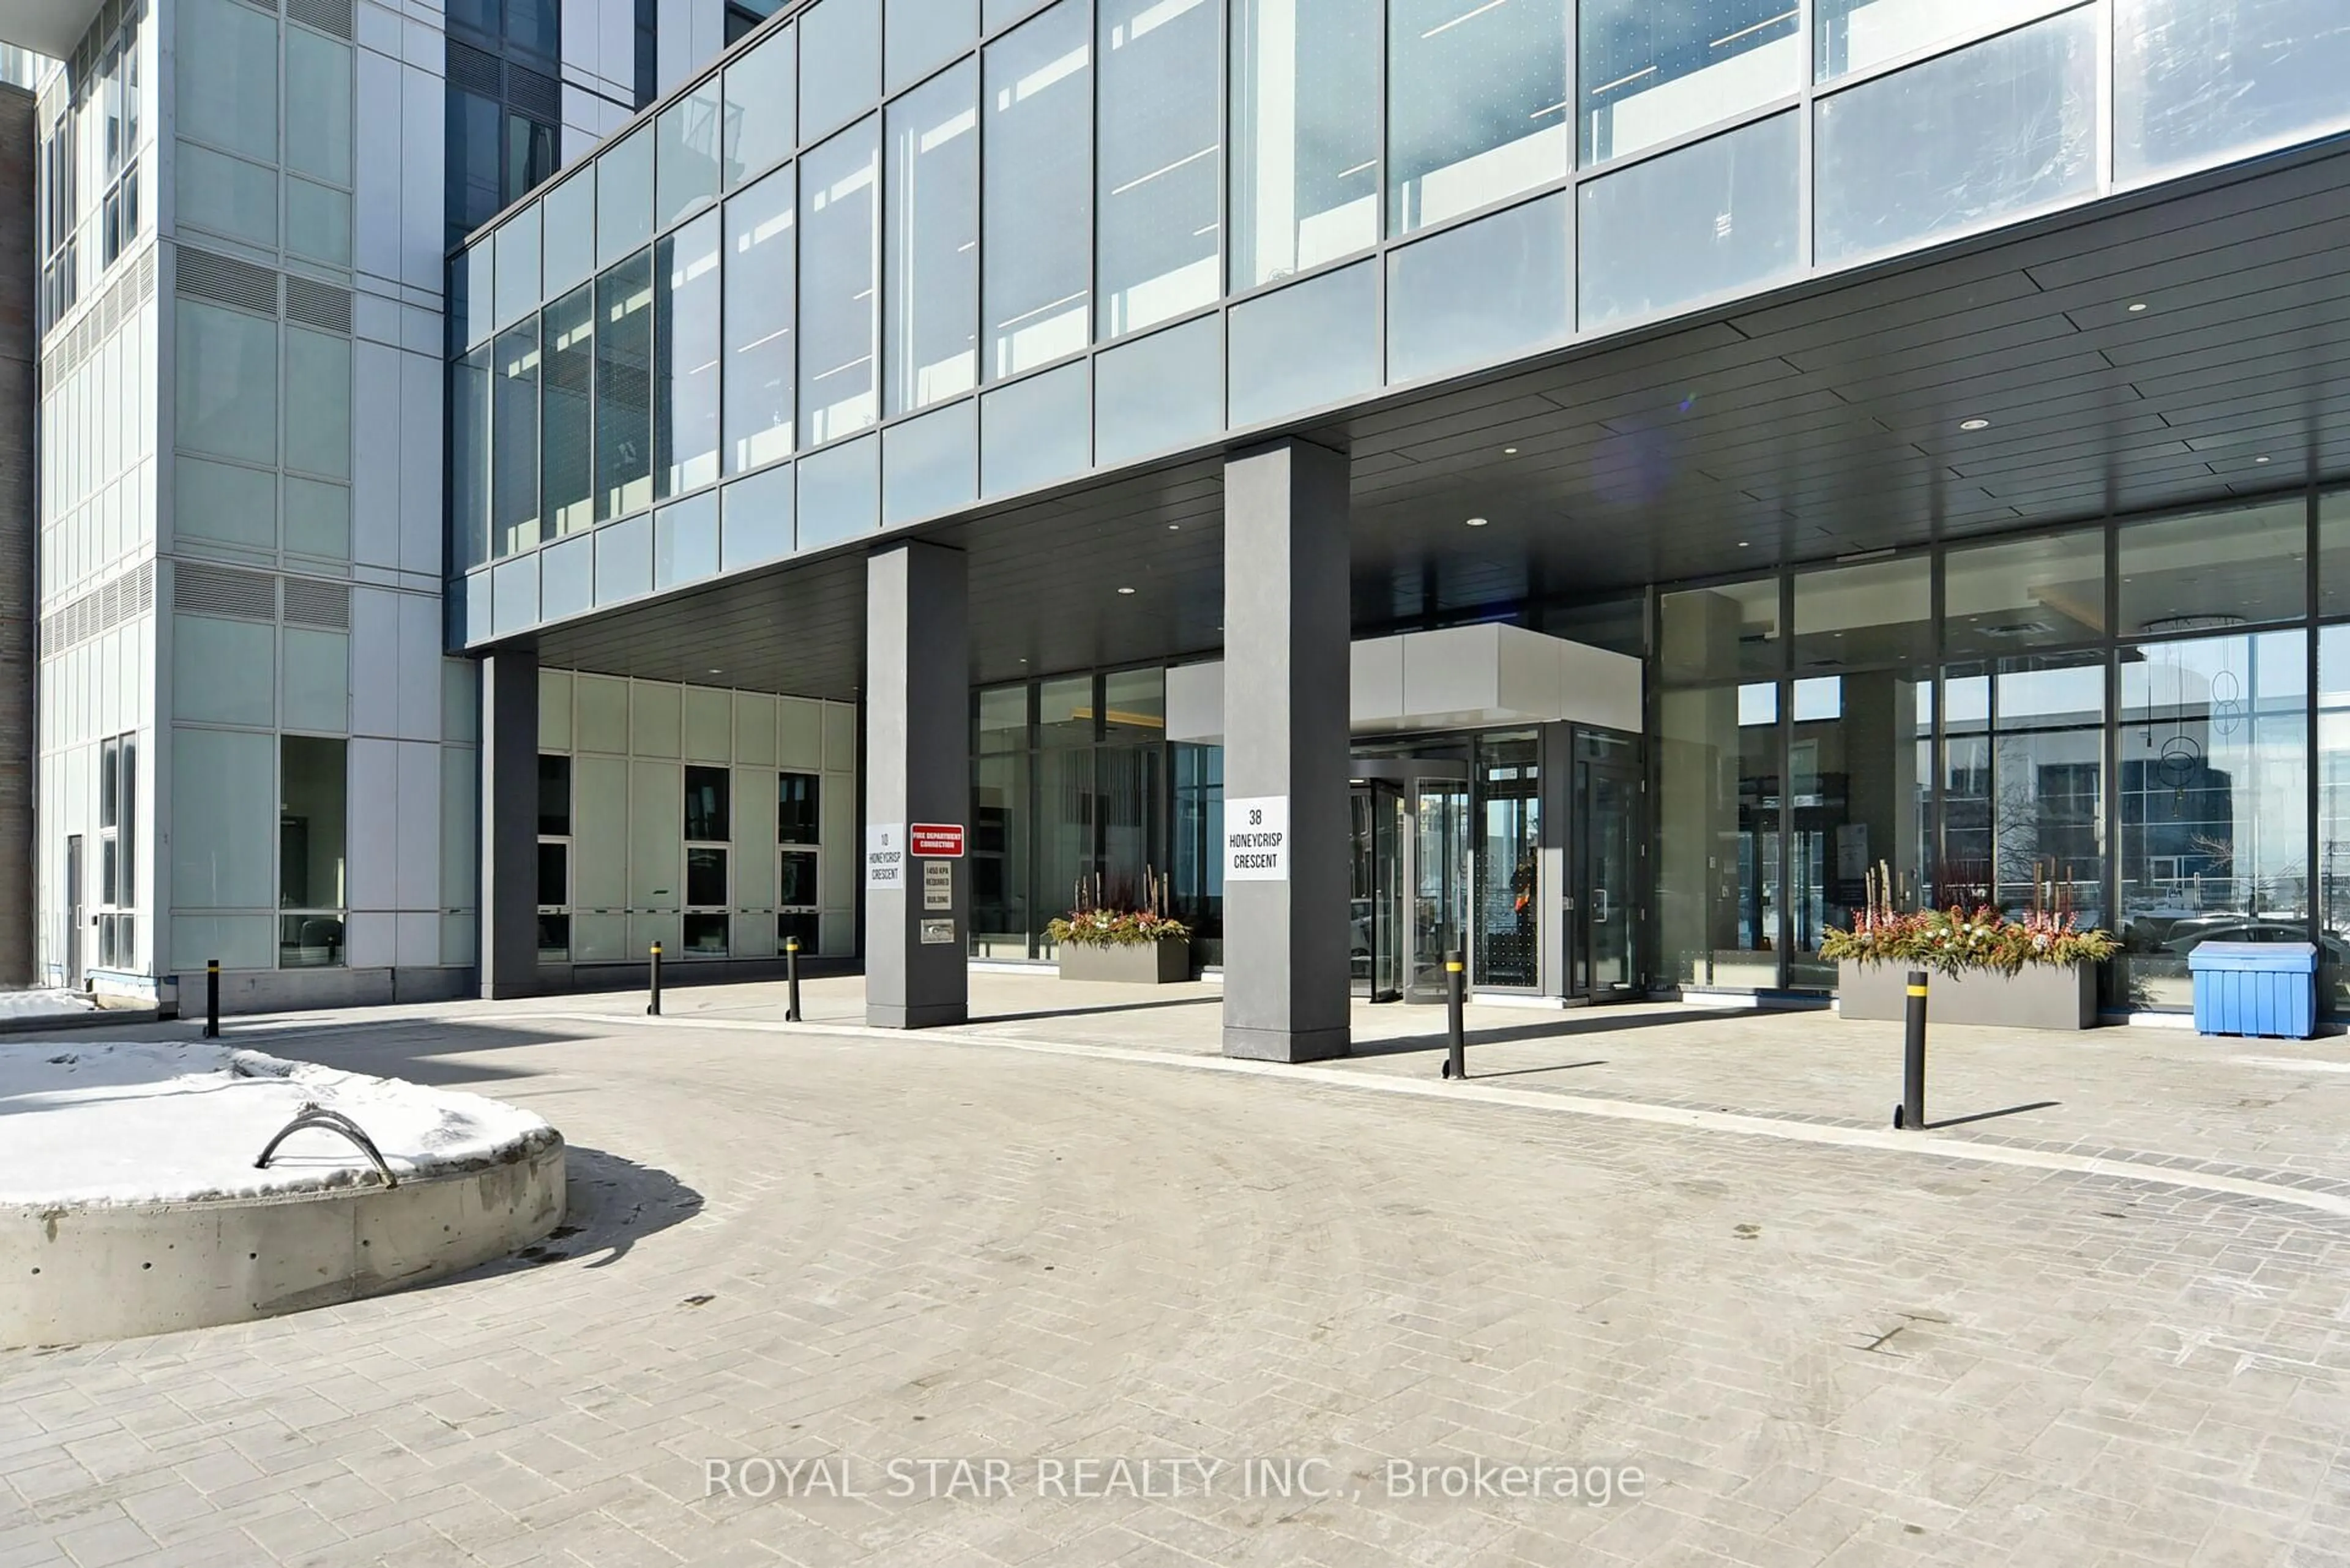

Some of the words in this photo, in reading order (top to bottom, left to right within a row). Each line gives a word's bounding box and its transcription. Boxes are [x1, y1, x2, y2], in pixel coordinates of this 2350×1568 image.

[1249, 809, 1262, 825] 38
[1229, 832, 1283, 848] HONEYCRISP
[869, 852, 901, 864] HONEYCRISP
[1234, 854, 1277, 868] CRESCENT
[871, 868, 898, 880] CRESCENT
